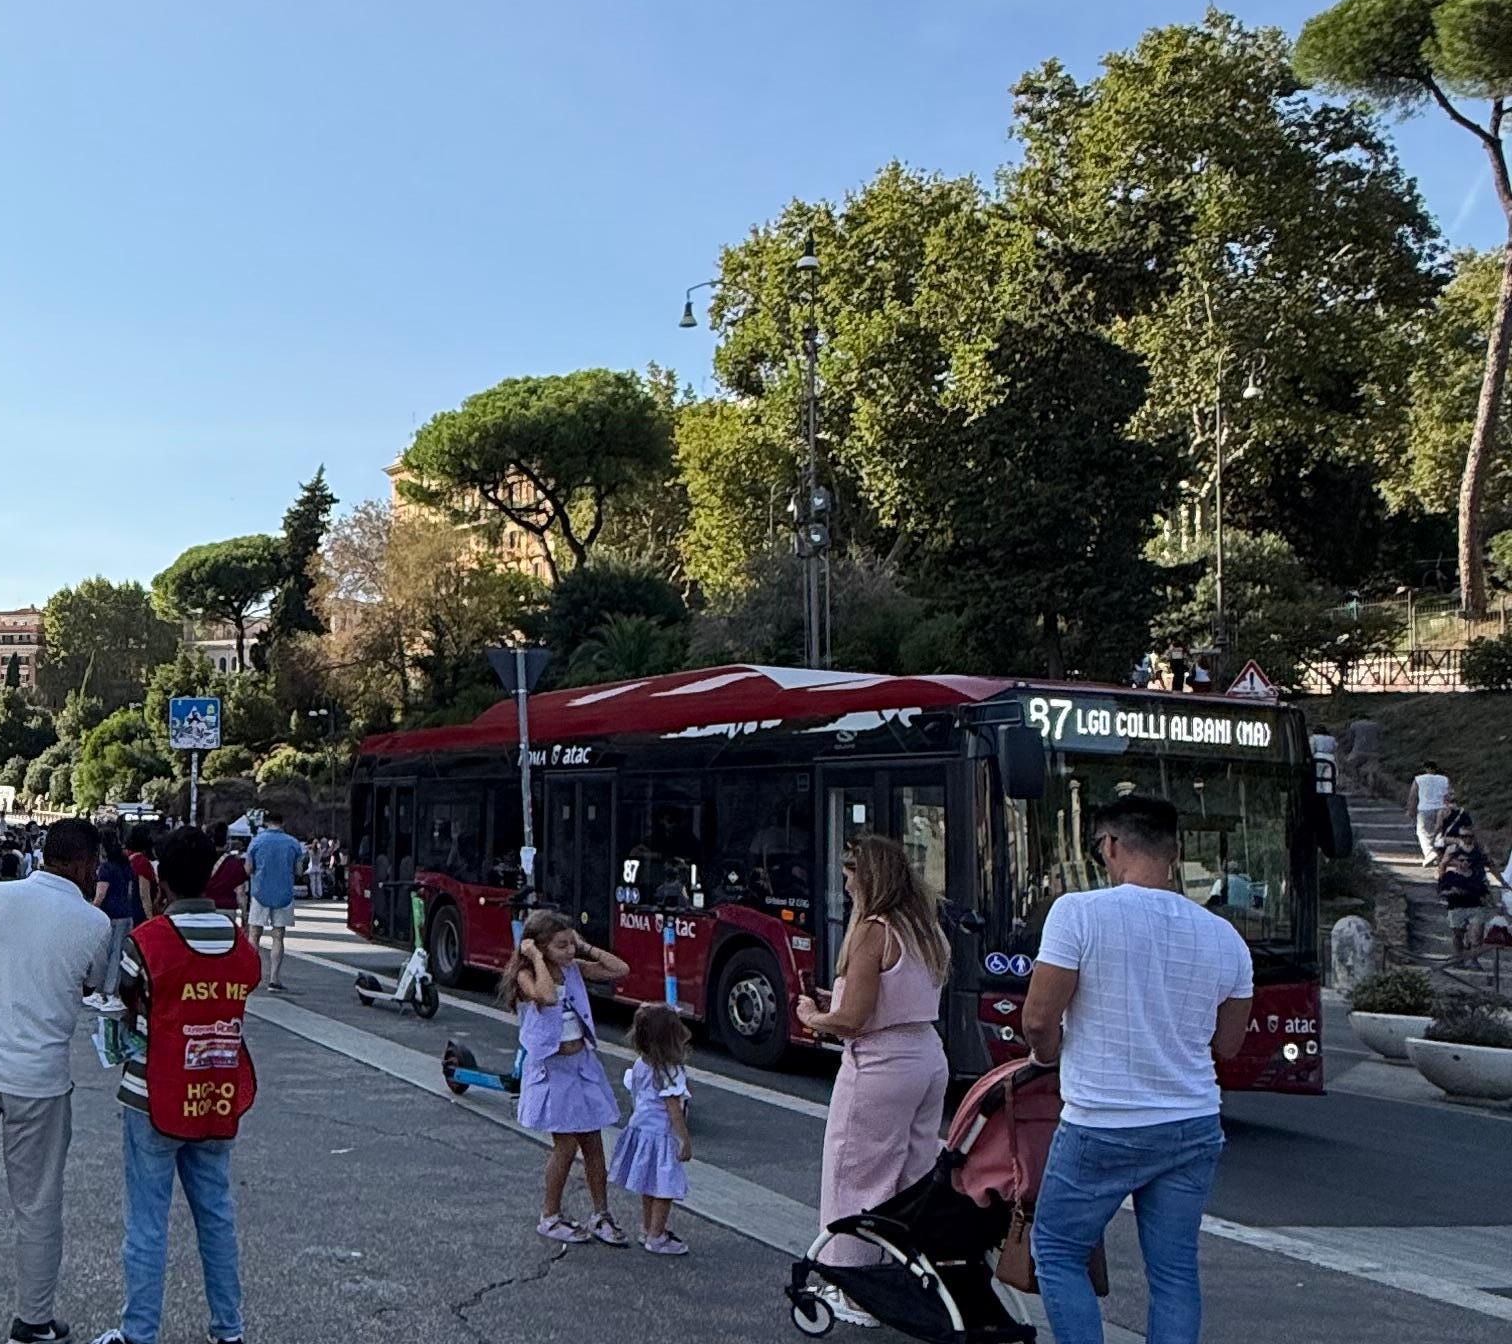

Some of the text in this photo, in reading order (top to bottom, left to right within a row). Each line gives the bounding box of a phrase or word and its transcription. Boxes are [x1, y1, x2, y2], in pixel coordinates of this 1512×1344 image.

[1029, 697, 1272, 748] 87 LGO COLLI ALBANI (MA)
[562, 744, 592, 765] atac
[622, 859, 640, 884] 87
[620, 913, 696, 938] ROMA tac
[180, 981, 249, 1001] ASK ME
[1284, 1016, 1317, 1034] atac
